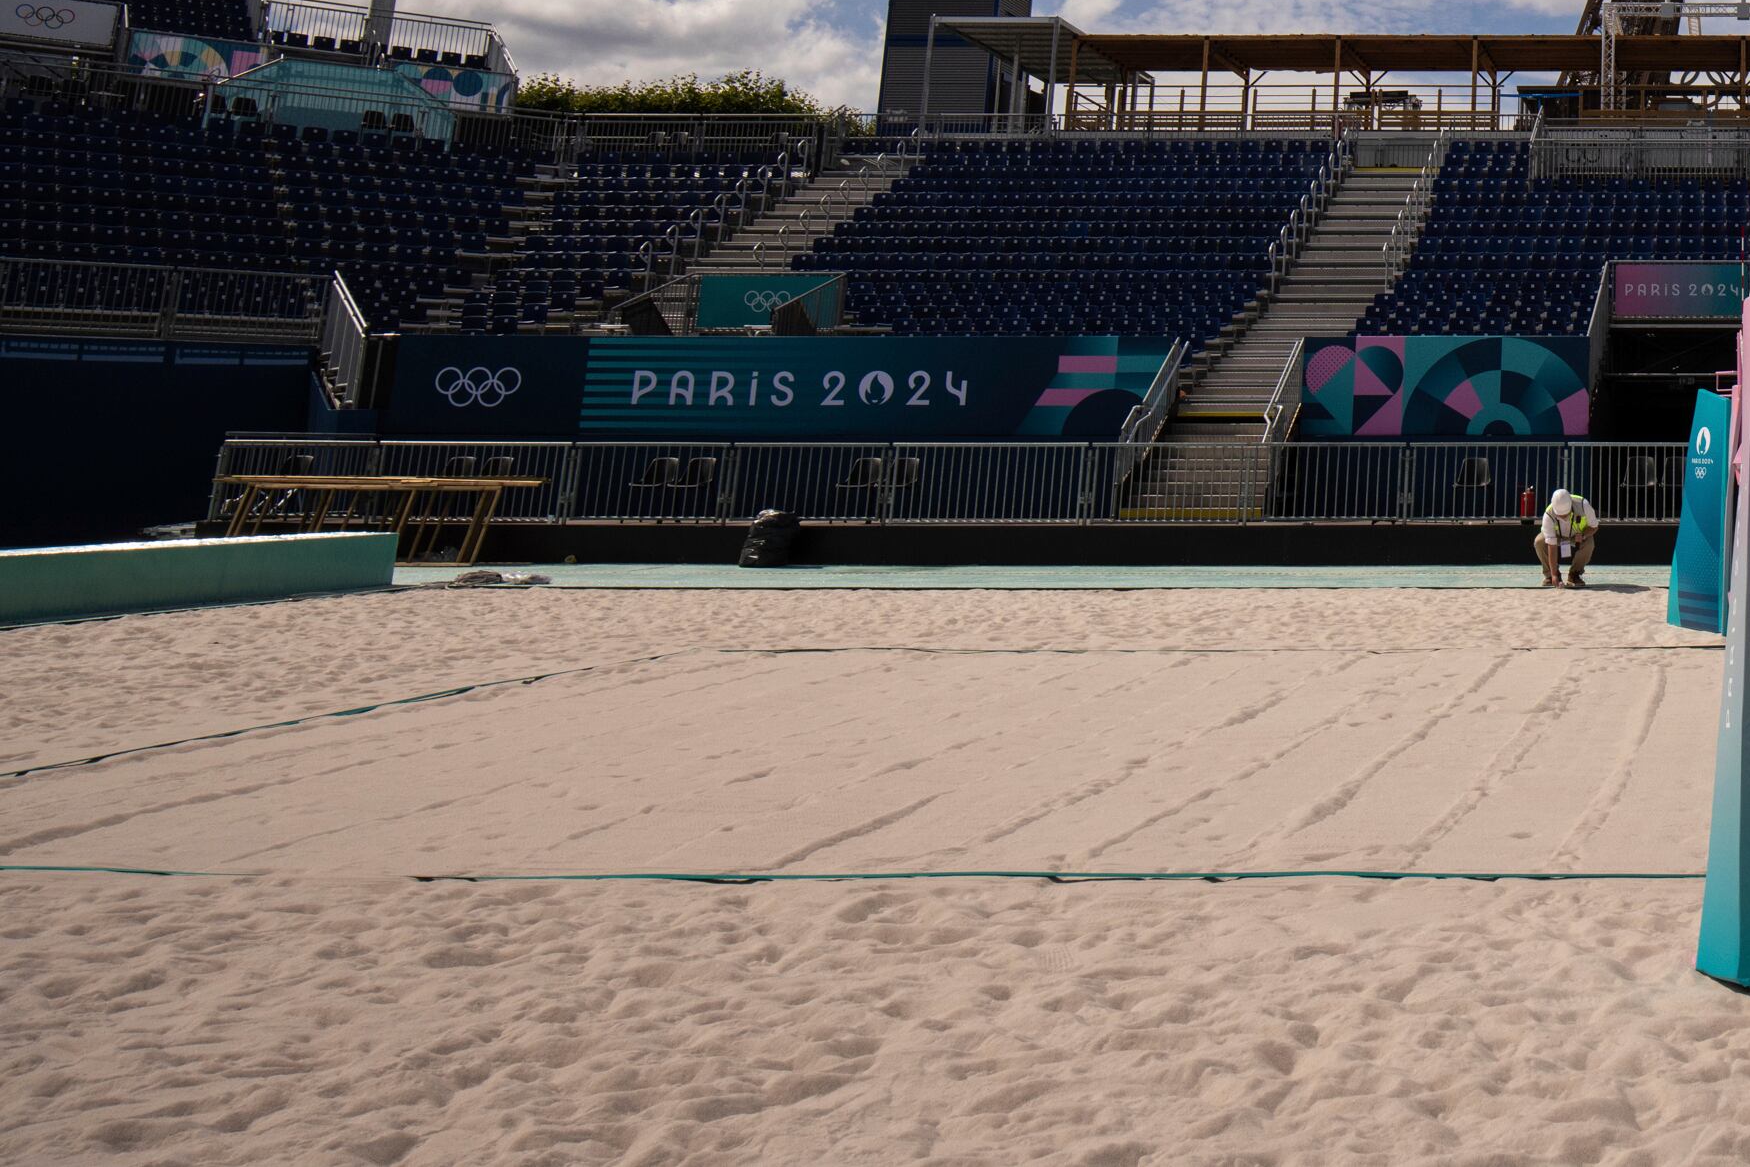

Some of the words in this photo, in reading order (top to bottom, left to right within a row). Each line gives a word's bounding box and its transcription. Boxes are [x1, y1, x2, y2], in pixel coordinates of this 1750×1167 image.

[1624, 283, 1681, 297] PARIS
[1688, 283, 1739, 297] 2024
[630, 369, 795, 407] PARIS
[819, 369, 968, 407] 2024
